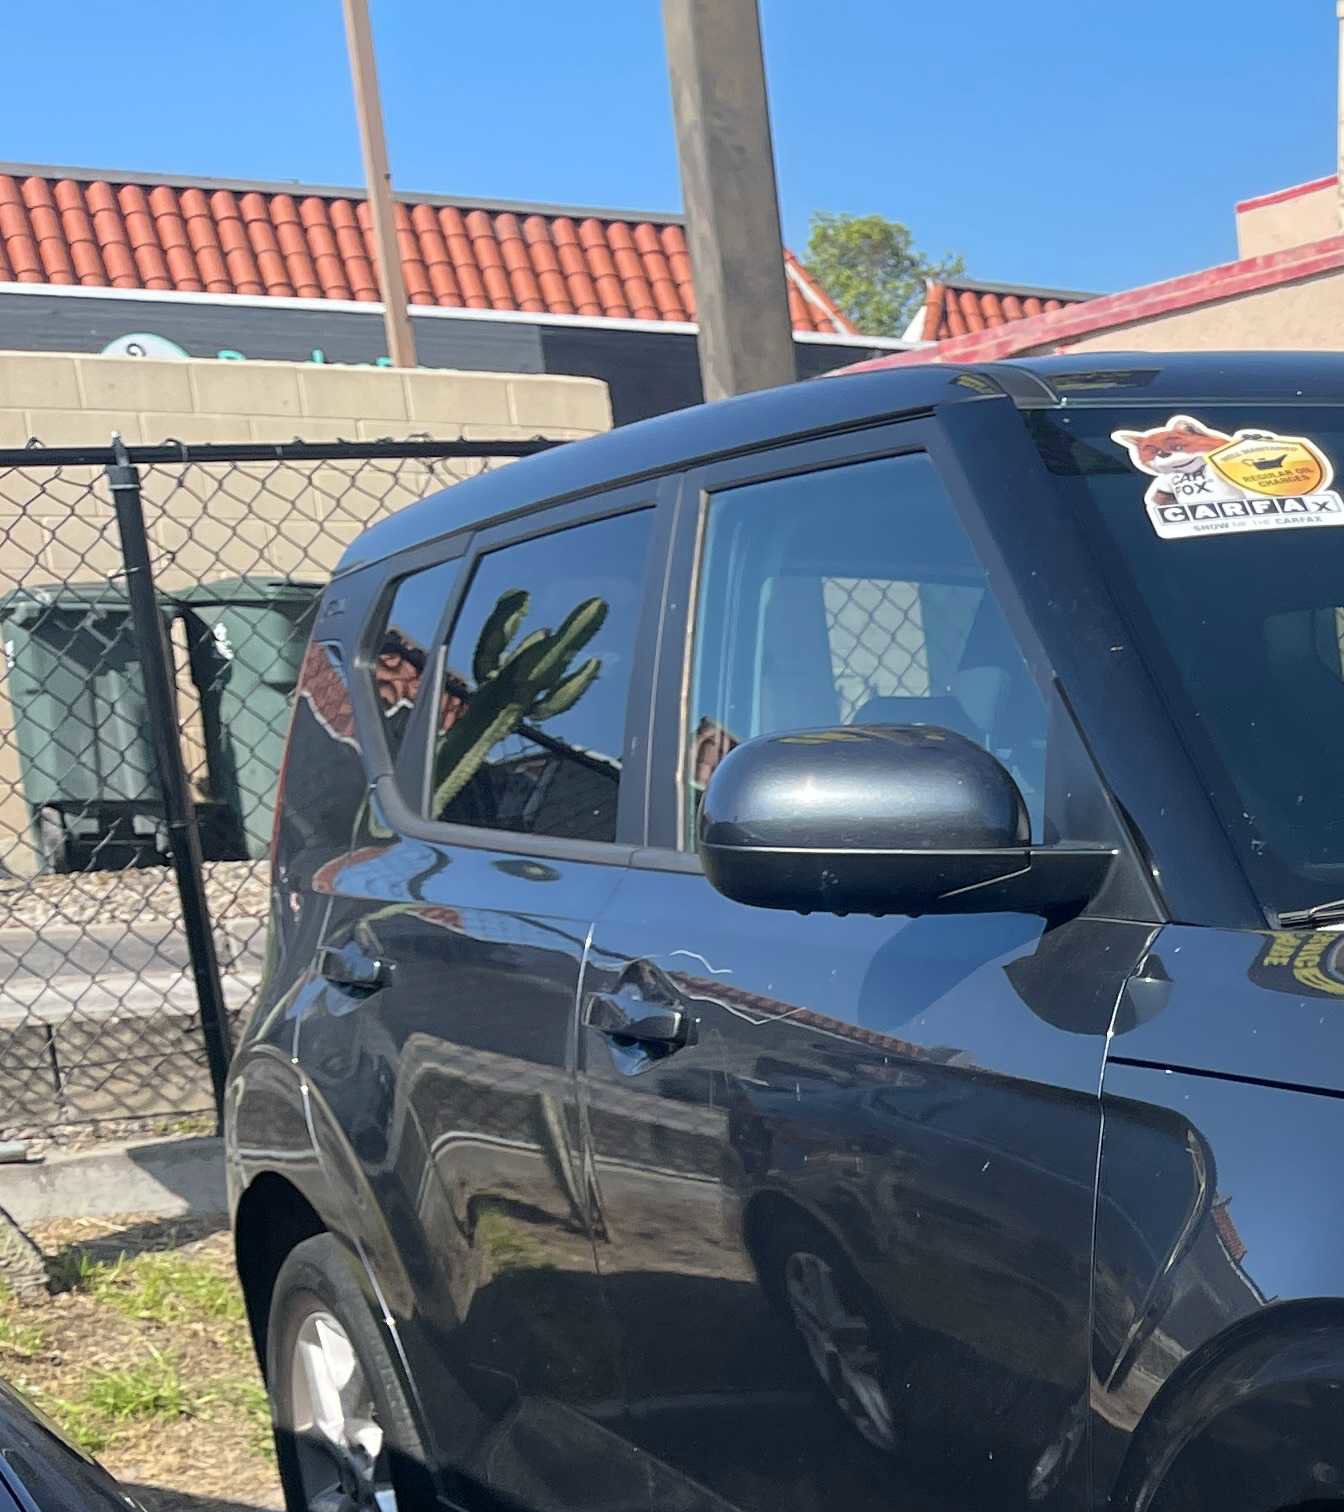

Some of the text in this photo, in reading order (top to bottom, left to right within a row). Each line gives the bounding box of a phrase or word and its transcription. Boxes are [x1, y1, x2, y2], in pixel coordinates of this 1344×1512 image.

[1258, 474, 1311, 487] CHANGES
[1159, 496, 1336, 524] CARFAX
[1194, 521, 1229, 531] SHOW
[1275, 515, 1323, 526] CARFAX
